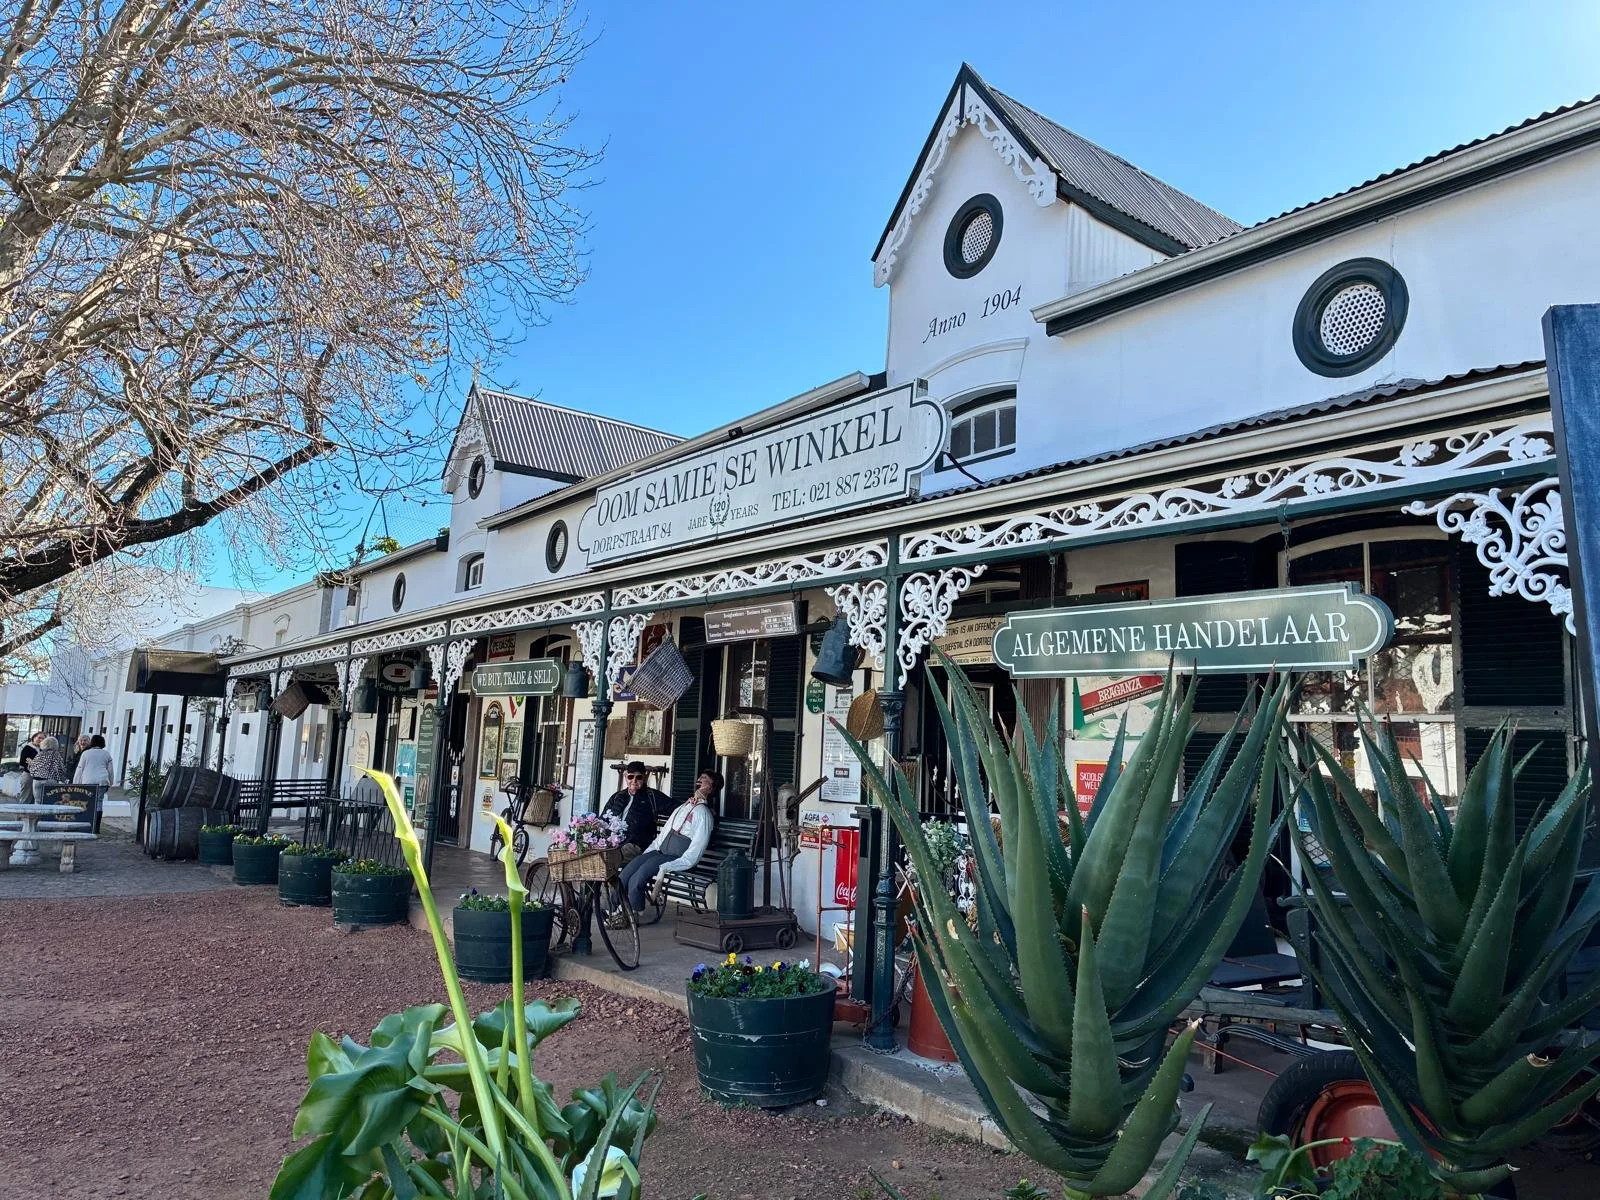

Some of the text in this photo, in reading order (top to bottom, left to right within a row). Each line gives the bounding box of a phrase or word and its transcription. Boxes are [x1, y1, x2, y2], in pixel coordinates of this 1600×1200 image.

[922, 285, 1021, 343] Anno 1904
[598, 406, 902, 526] OOM SAMIE SE WINKEL
[772, 463, 898, 511] TEL: 021 887 2372
[714, 501, 725, 513] 120
[731, 504, 758, 520] YEARS
[688, 516, 708, 530] JARE
[593, 522, 672, 555] DORPSTRAAT 84
[1012, 612, 1350, 657] ALGEMENE HANDELAAR
[477, 670, 553, 687] WE BUY, TRADE & SELL
[1097, 678, 1143, 702] BRAGANZA
[804, 813, 819, 821] AGFA
